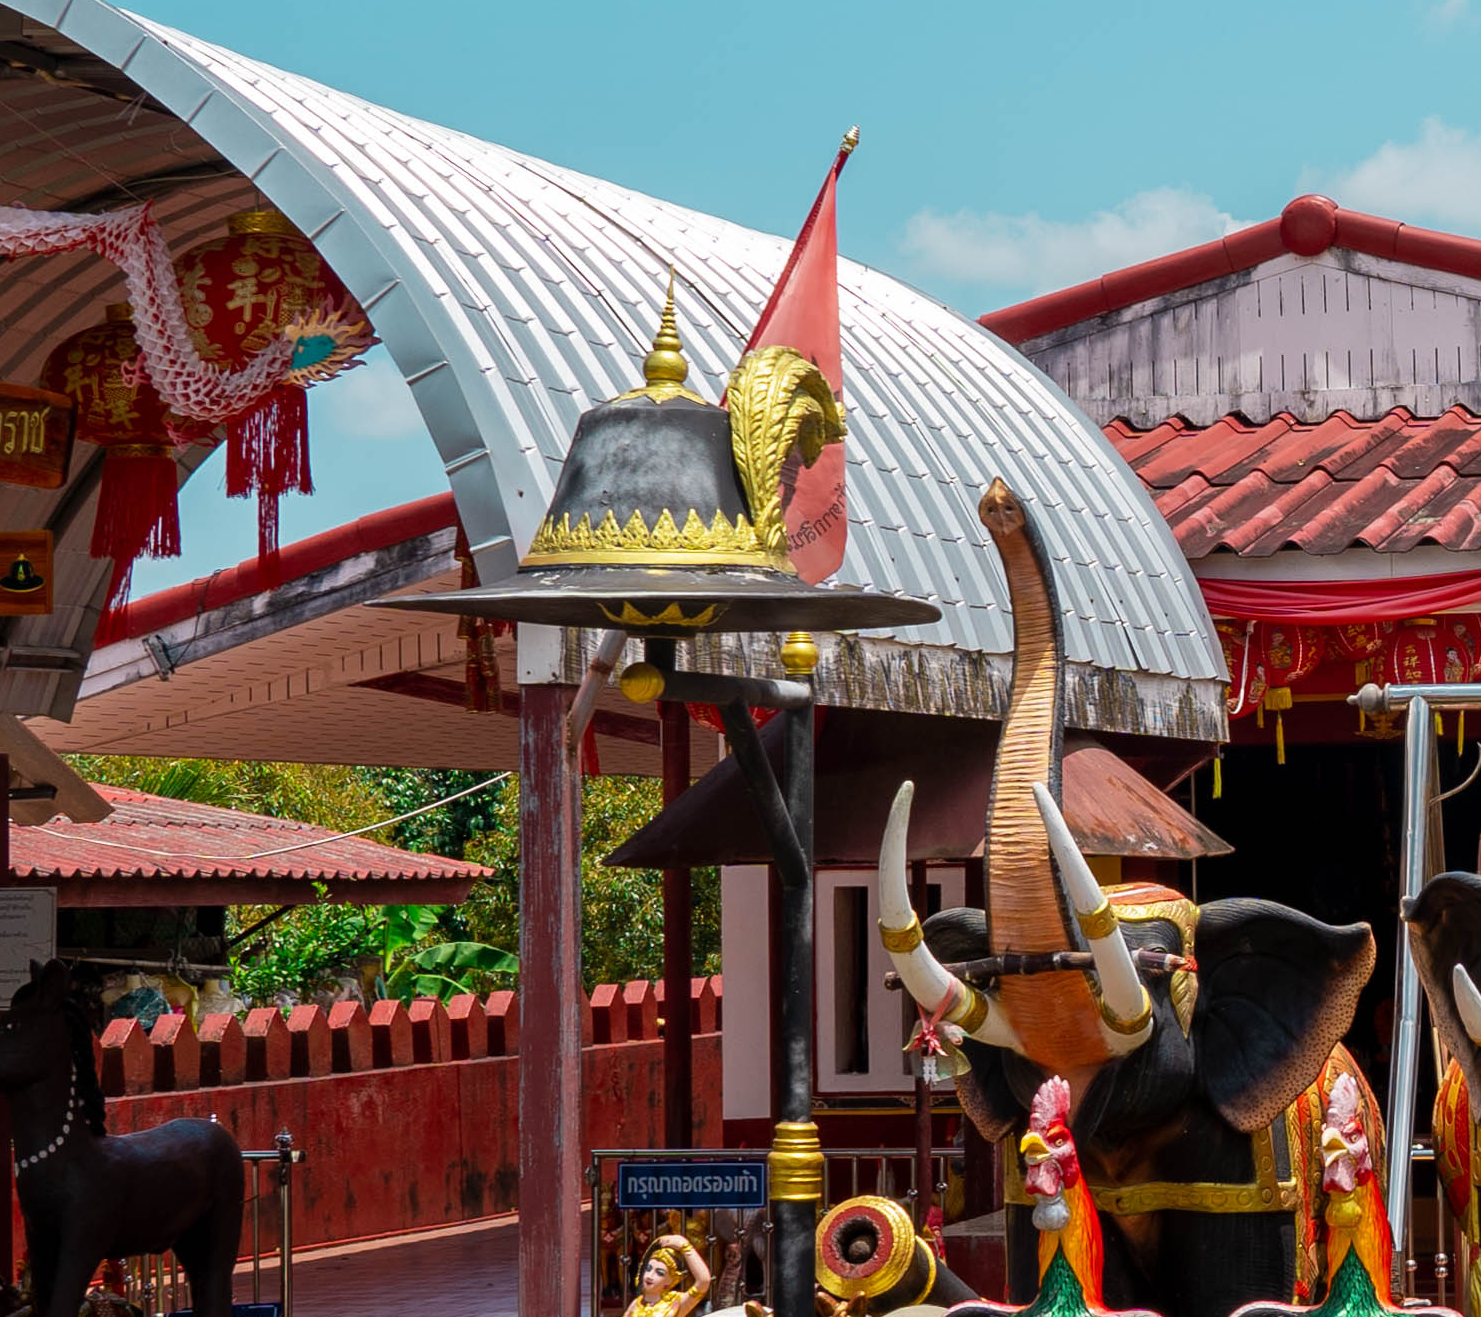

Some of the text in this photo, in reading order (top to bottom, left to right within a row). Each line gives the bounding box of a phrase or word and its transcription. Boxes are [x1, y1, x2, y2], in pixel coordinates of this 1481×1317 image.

[627, 1169, 758, 1200] กรุณาถอดรองเท้า
